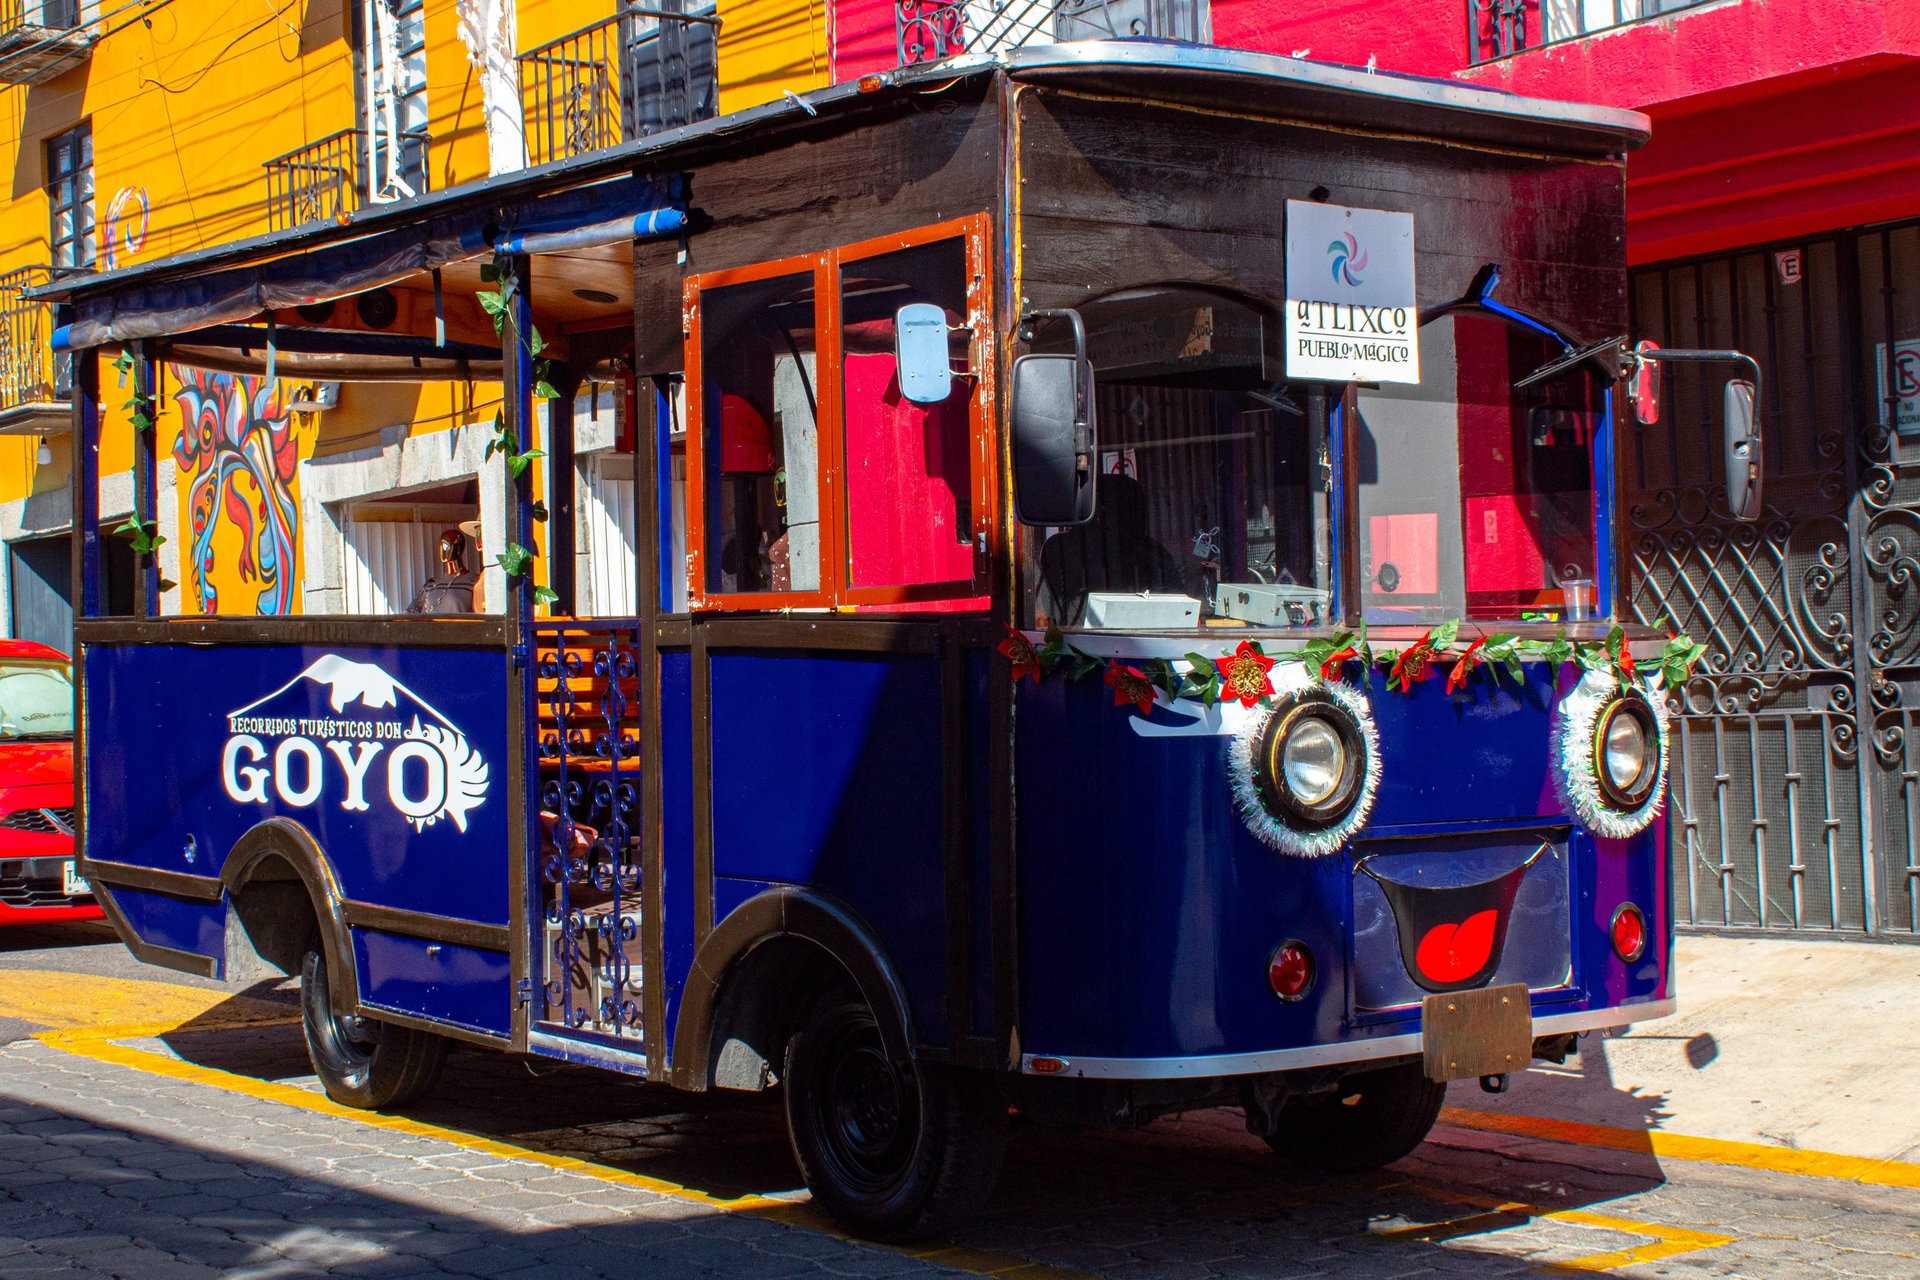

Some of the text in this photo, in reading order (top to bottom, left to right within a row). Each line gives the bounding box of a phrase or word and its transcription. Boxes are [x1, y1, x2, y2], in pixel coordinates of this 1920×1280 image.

[1785, 258, 1798, 277] E
[1901, 358, 1915, 390] E
[230, 716, 402, 739] RECORRIDOS TURÍSTICOS DON
[222, 734, 445, 818] GOYO
